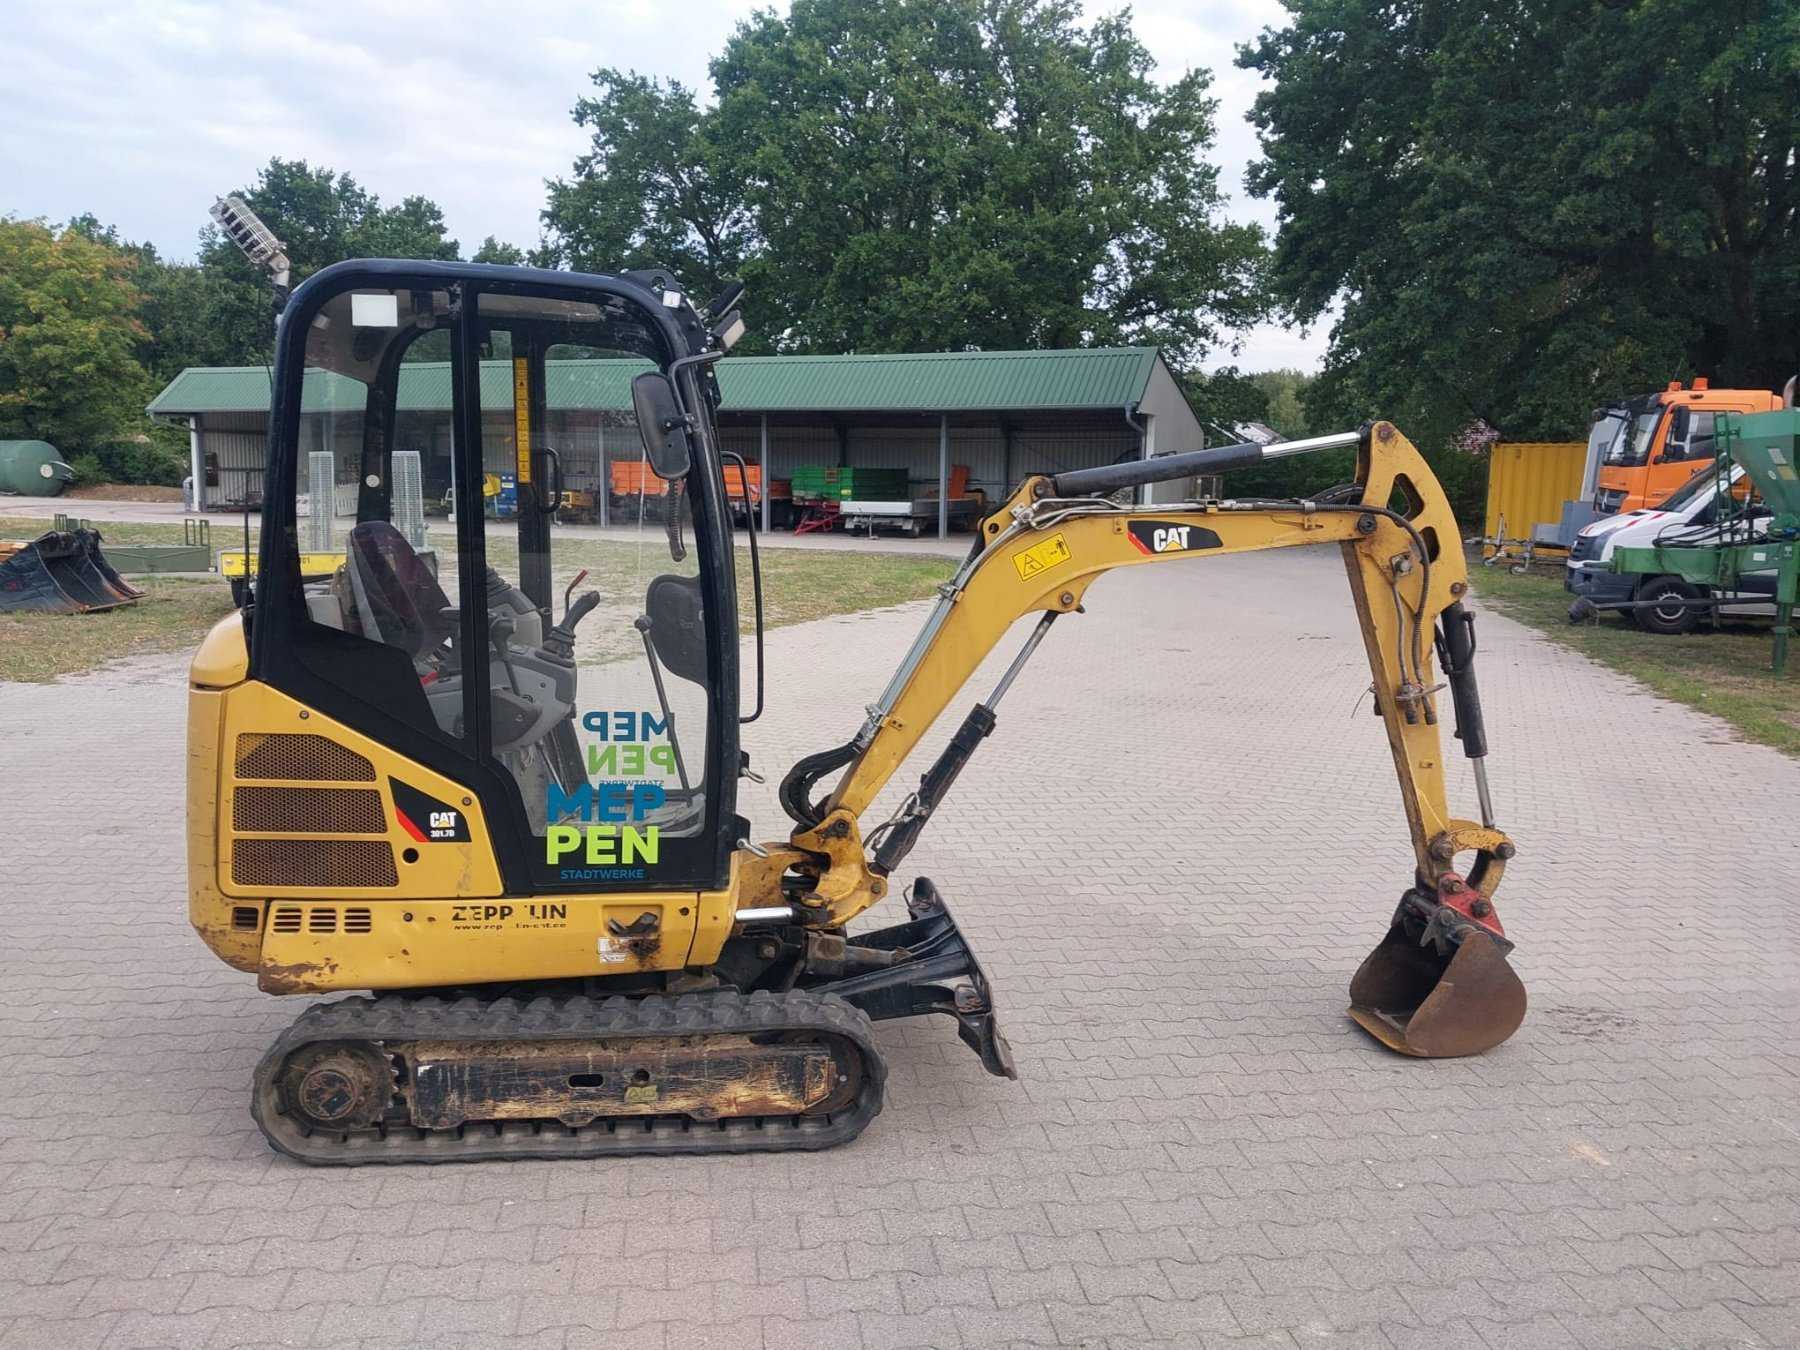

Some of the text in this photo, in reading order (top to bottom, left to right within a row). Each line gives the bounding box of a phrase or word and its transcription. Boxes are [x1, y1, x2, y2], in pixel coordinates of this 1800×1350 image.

[1153, 527, 1190, 552] CAT
[547, 783, 666, 822] MEP
[430, 812, 456, 828] CAT
[546, 825, 659, 865] PEN
[560, 869, 646, 880] STADTWERKE
[452, 904, 567, 920] ZEPPLIN
